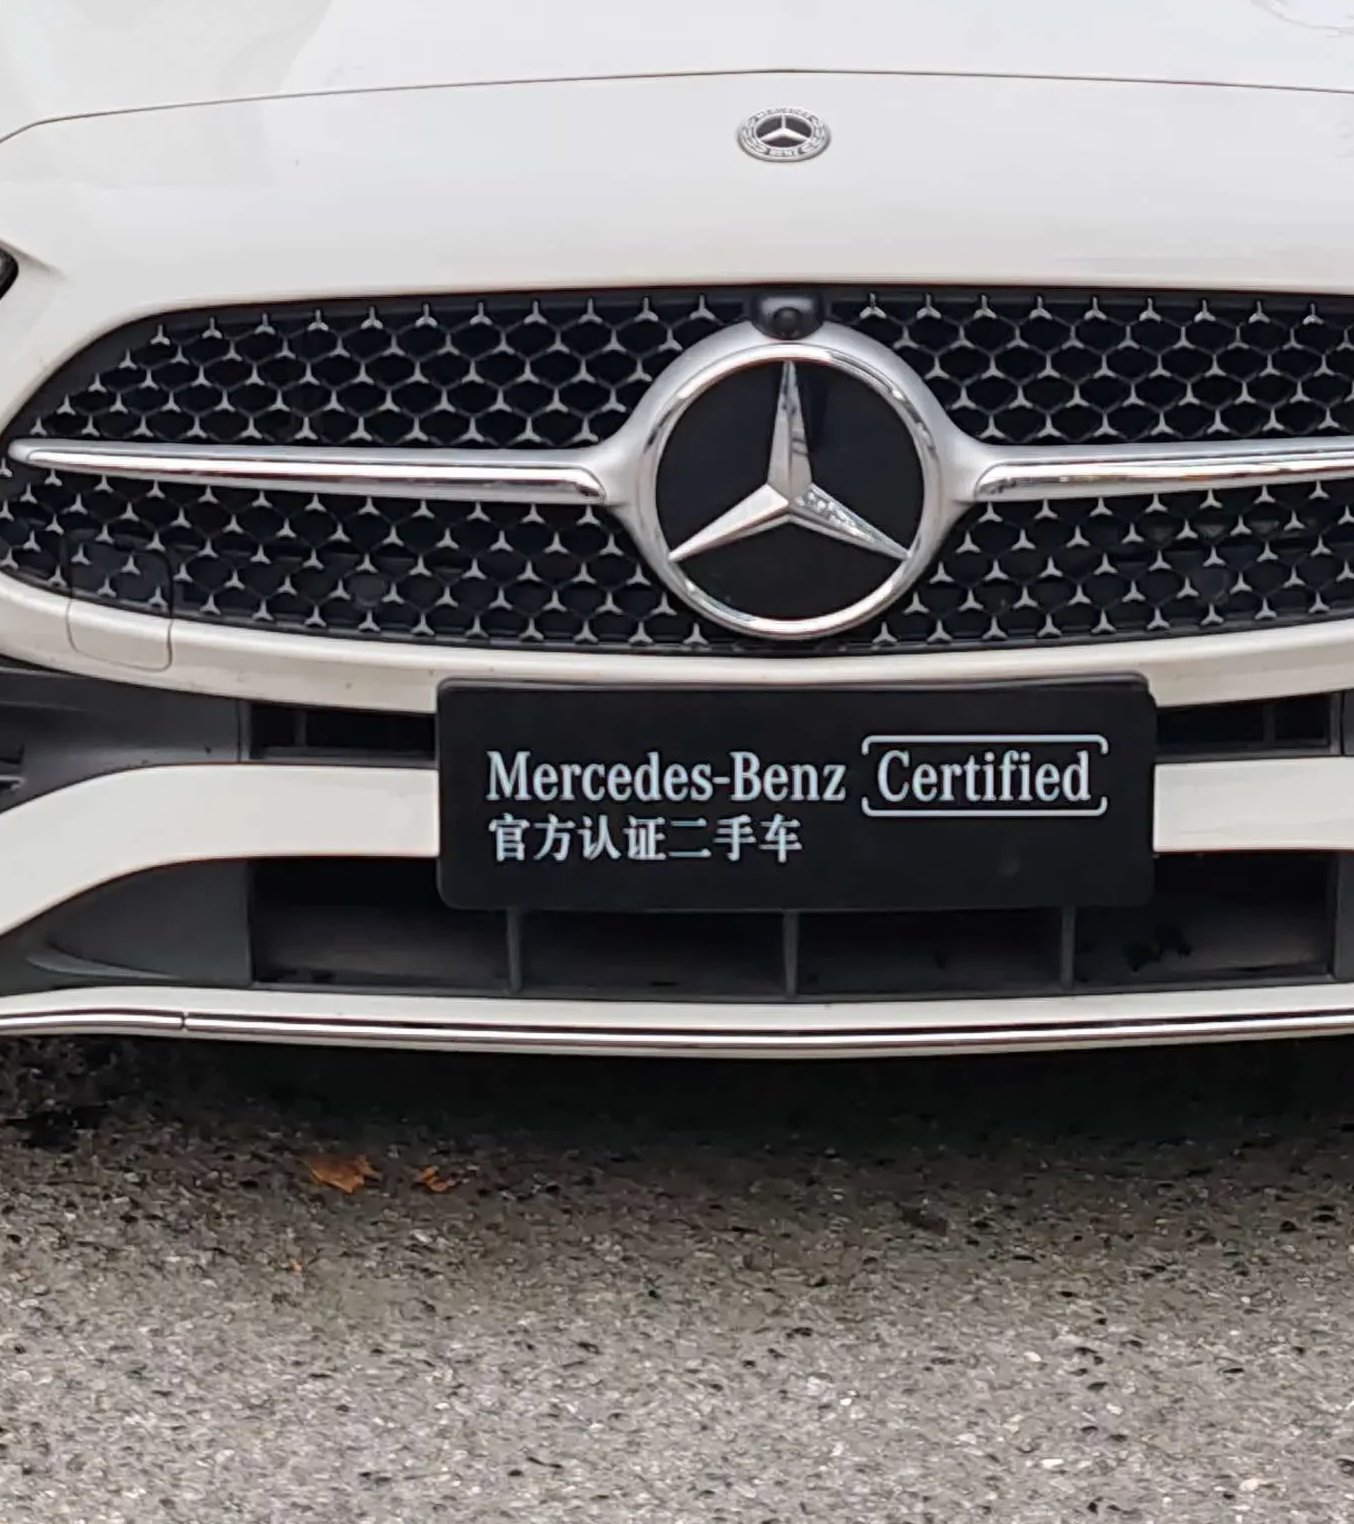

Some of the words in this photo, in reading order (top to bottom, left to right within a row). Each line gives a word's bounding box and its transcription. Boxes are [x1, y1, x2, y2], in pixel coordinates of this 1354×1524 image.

[486, 750, 847, 803] Mercedes-Benz
[876, 749, 1092, 803] Certified
[488, 813, 803, 863] 官方认证二手车
